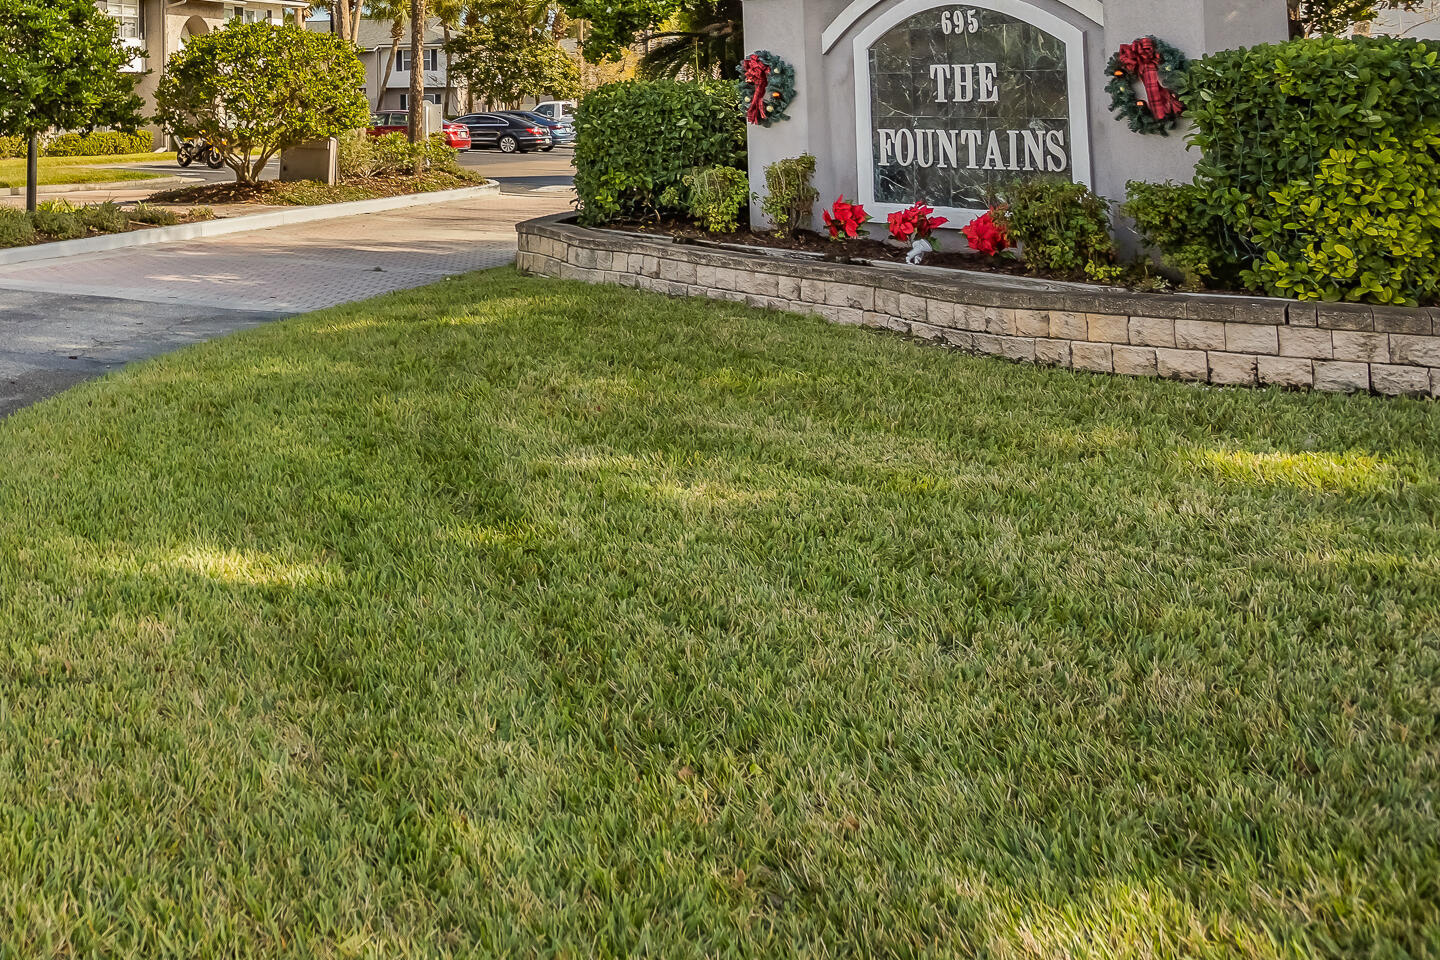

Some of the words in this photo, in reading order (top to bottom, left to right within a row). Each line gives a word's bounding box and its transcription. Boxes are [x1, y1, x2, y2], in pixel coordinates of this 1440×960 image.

[941, 9, 979, 34] 695
[930, 62, 999, 103] THE
[877, 128, 1067, 173] FOUNTAINS
